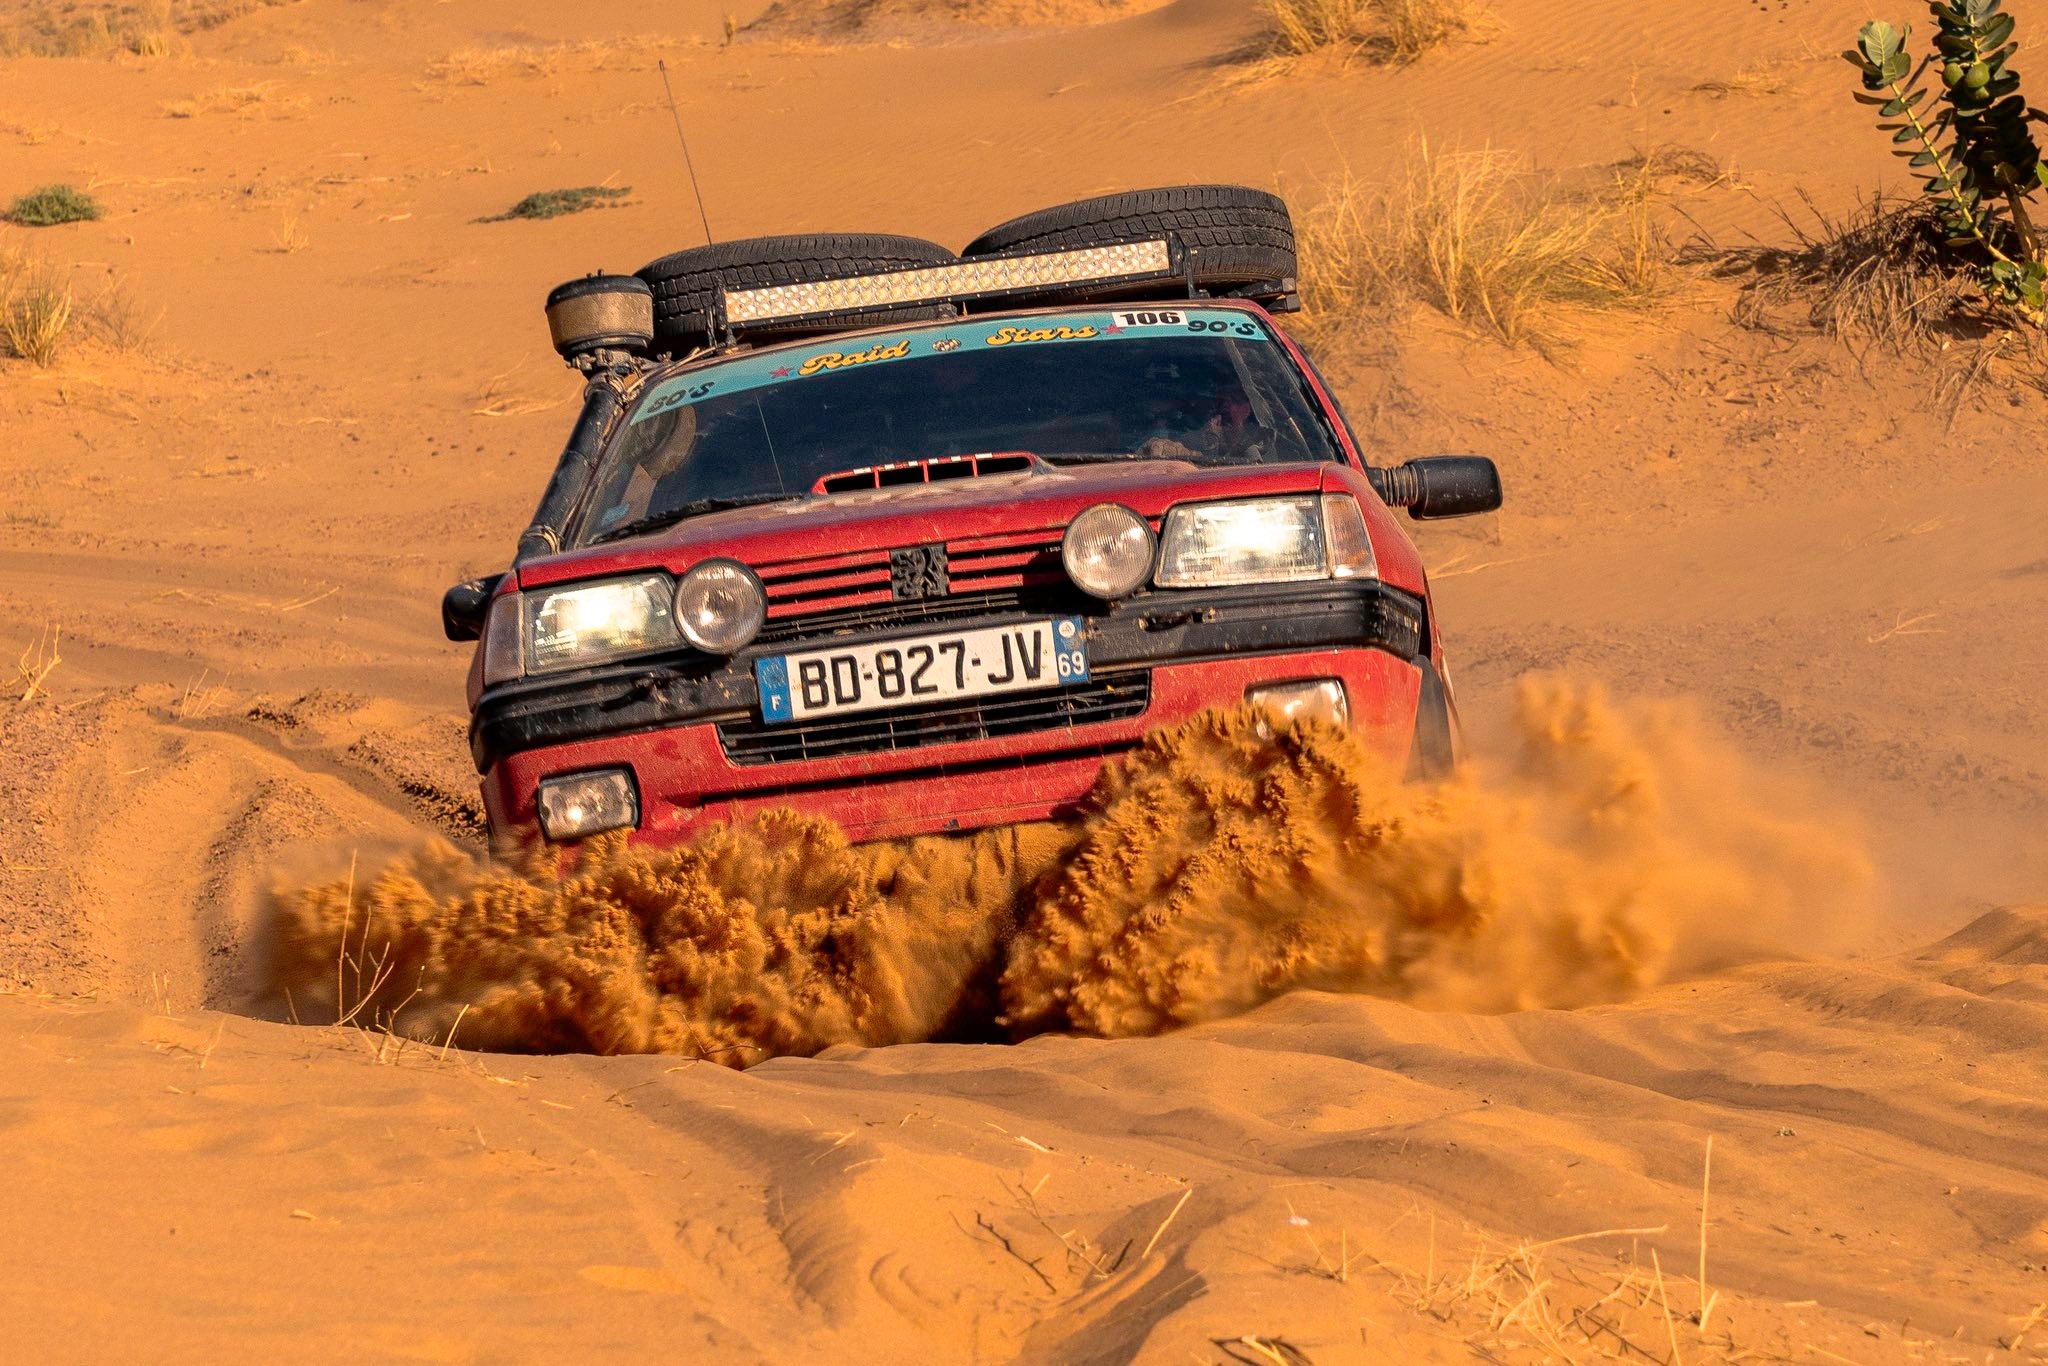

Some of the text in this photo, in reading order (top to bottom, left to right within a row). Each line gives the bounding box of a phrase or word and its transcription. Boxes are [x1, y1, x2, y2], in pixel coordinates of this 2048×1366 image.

[1119, 311, 1181, 326] 106
[798, 325, 1099, 376] Raid Stars
[798, 629, 1042, 711] BD-827-JV
[1057, 650, 1085, 677] 69
[770, 694, 782, 712] F
